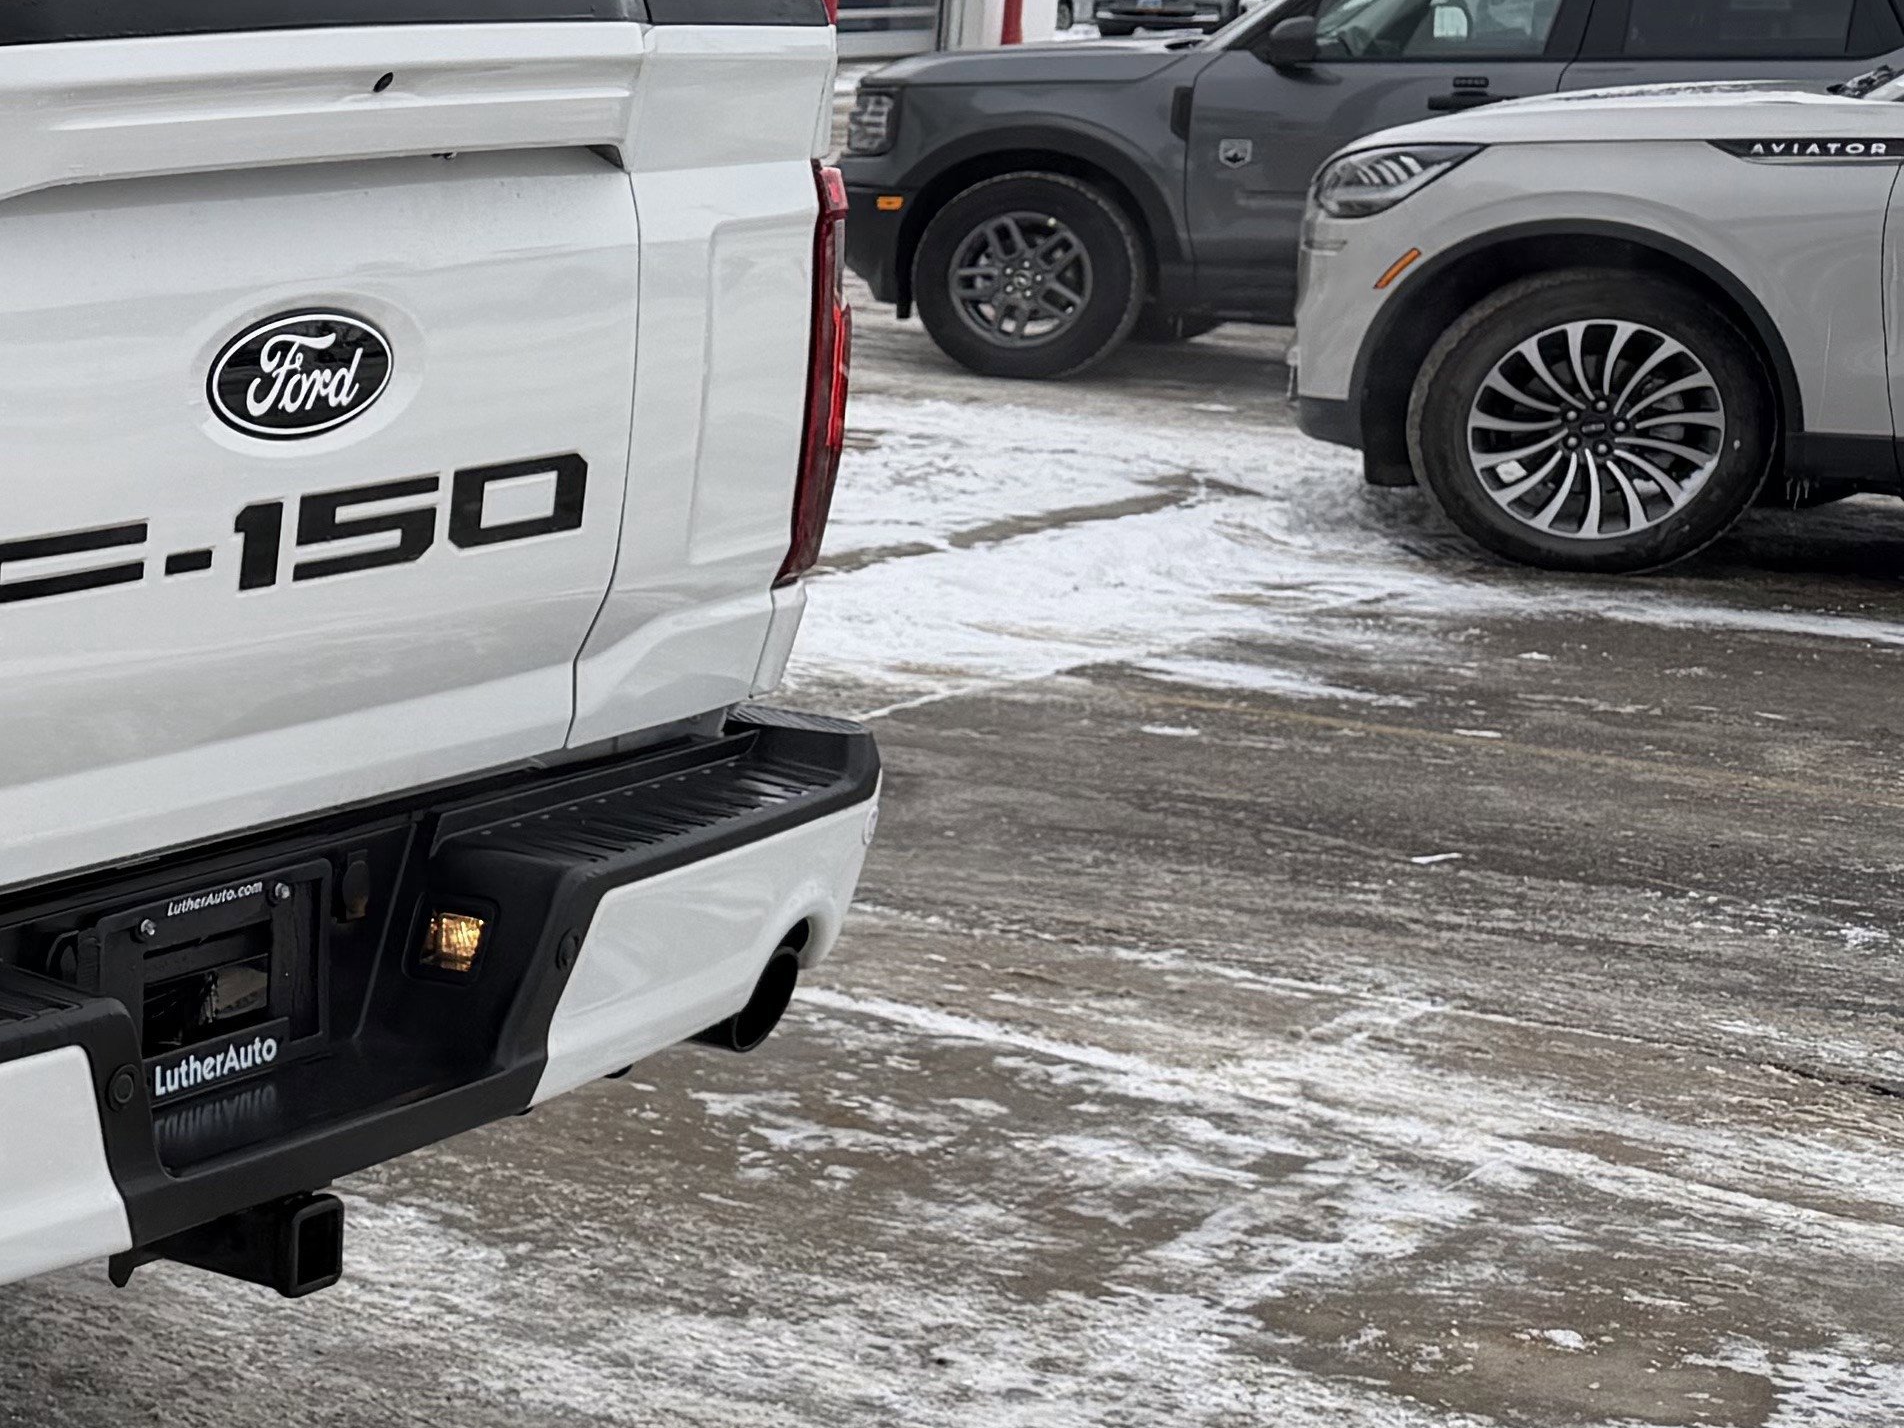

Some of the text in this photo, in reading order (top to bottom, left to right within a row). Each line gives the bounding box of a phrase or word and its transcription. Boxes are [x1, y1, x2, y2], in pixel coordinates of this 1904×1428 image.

[1750, 142, 1887, 155] AVIATOR
[246, 332, 364, 417] Ford
[167, 880, 263, 917] LutherAuto.com
[154, 1035, 278, 1097] LutherAuto
